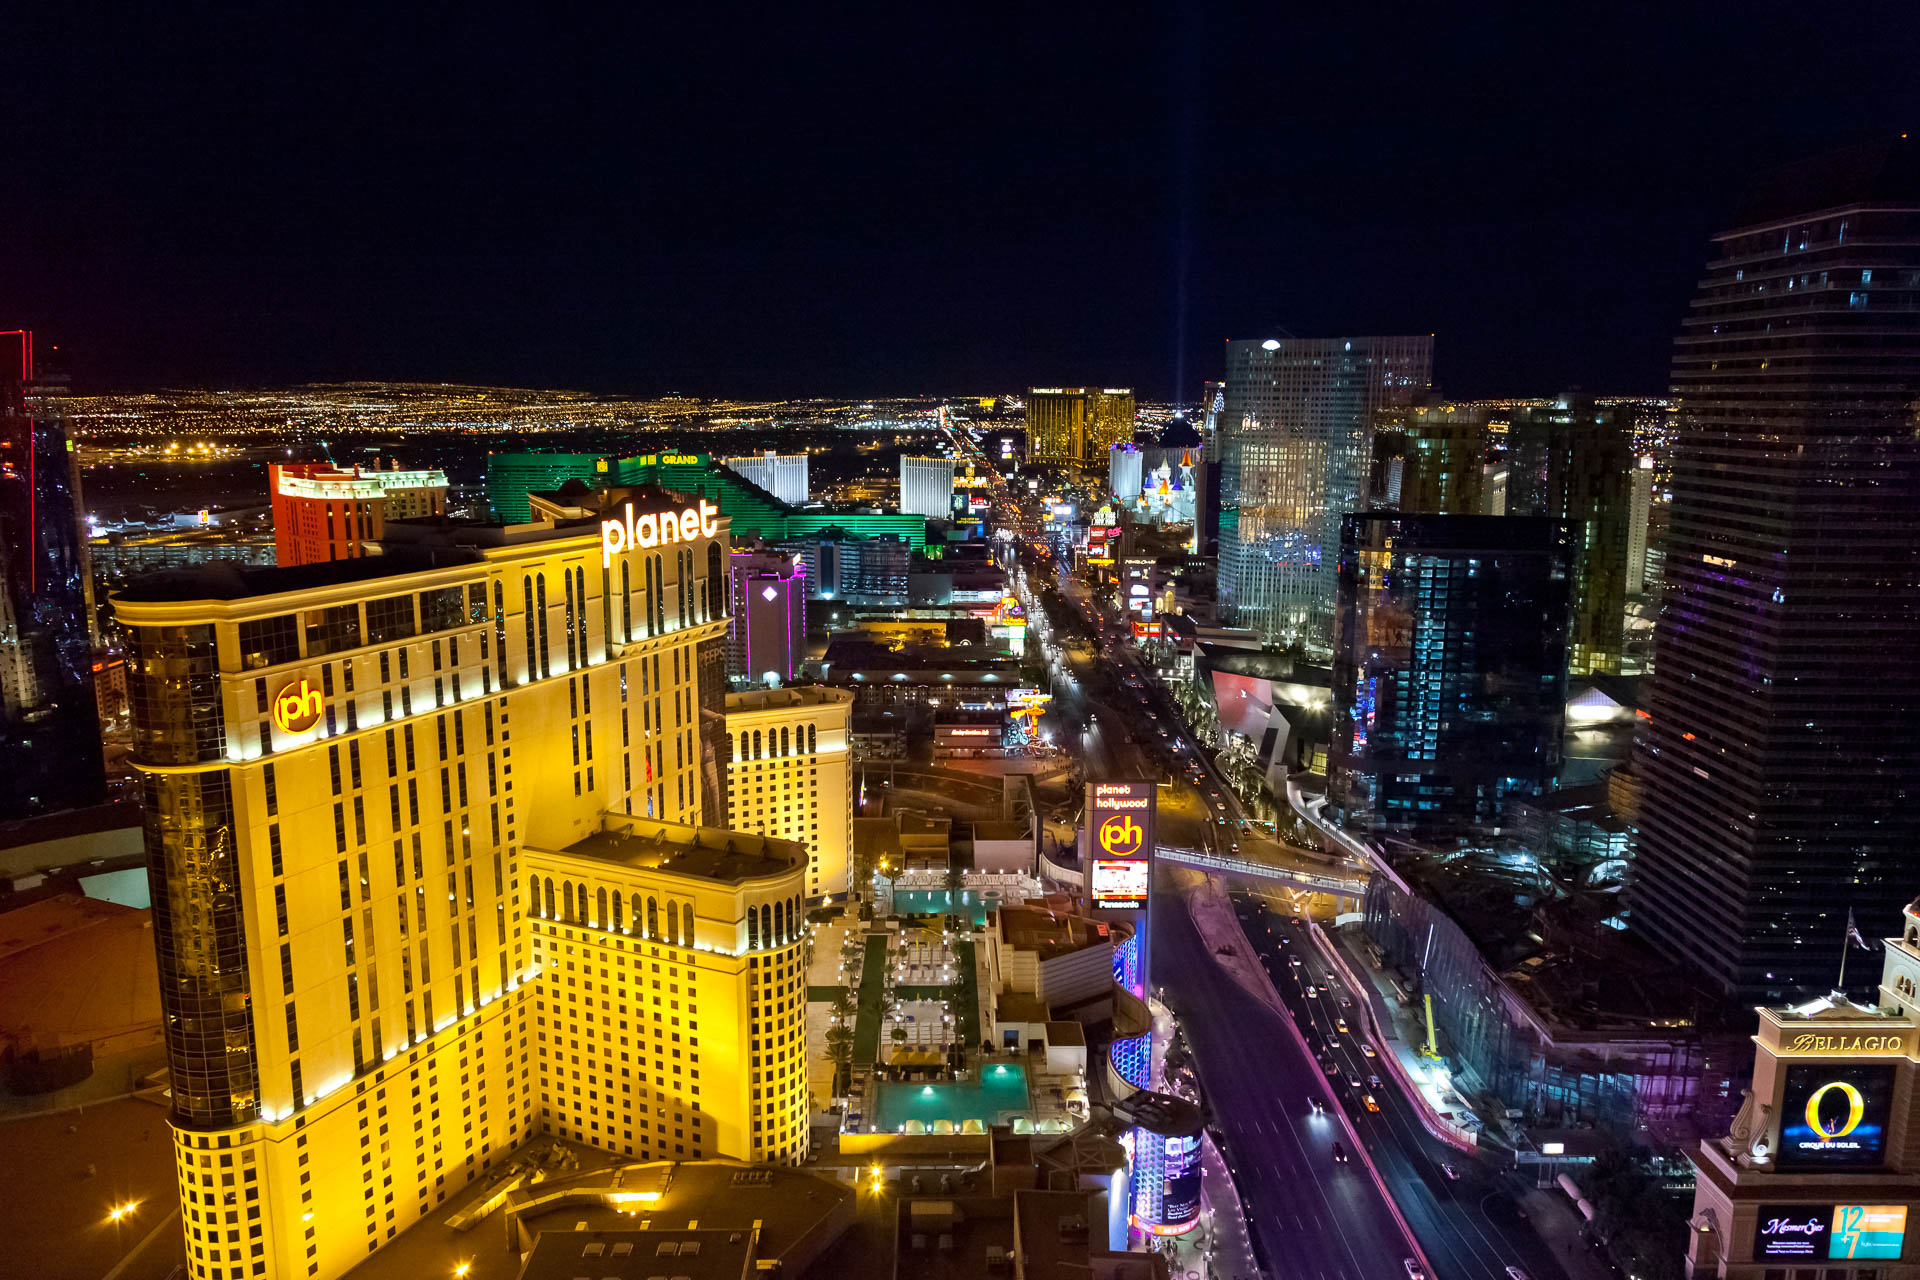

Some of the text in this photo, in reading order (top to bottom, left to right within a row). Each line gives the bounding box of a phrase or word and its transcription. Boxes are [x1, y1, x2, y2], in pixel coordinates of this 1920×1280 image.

[662, 455, 698, 464] GRAND
[601, 499, 718, 569] planet
[278, 679, 323, 730] ph
[1096, 784, 1131, 796] planet
[1096, 798, 1148, 810] hollywood
[1102, 815, 1143, 852] ph
[1099, 901, 1139, 909] Panasonic
[1786, 1034, 1902, 1051] BELLAGIO
[1805, 1082, 1864, 1137] O
[1799, 1142, 1824, 1150] CIRQUE
[1840, 1206, 1864, 1235] 12
